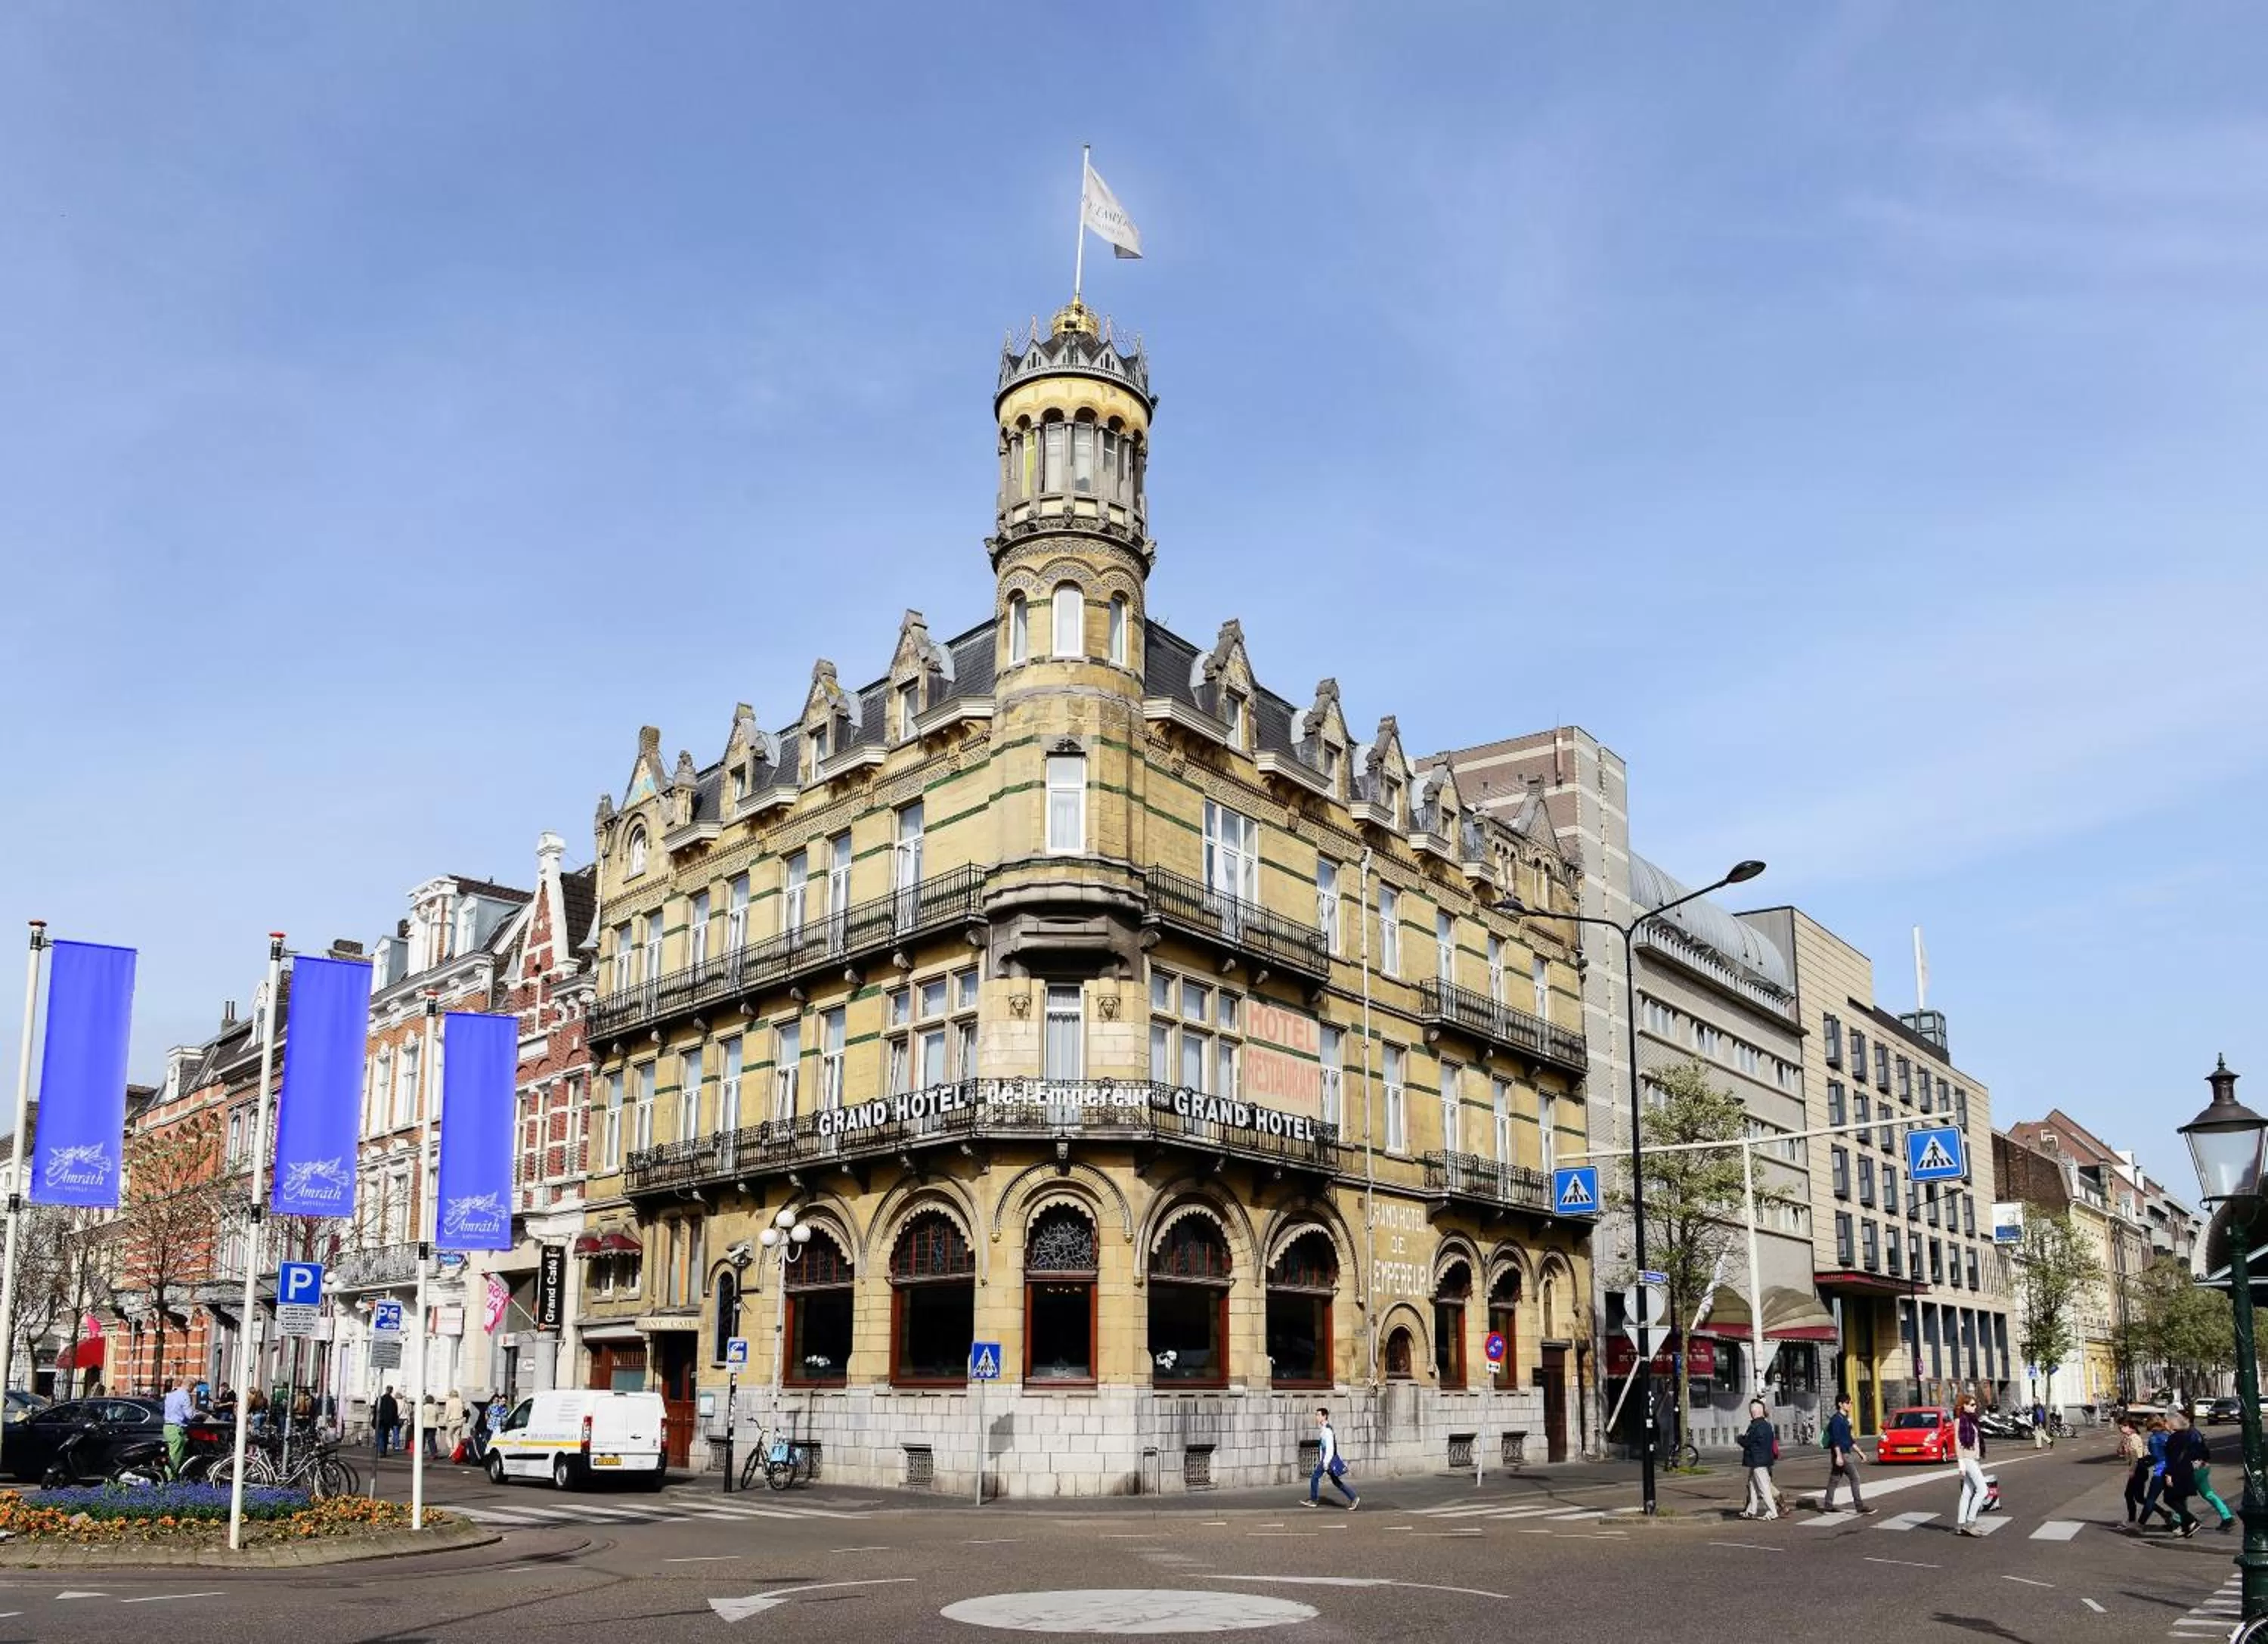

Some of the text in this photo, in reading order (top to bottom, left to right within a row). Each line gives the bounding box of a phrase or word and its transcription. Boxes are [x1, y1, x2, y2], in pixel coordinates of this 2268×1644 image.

[1250, 1002, 1316, 1052] HOTEL
[987, 1080, 1015, 1106] de
[1247, 1050, 1318, 1107] RESTAURANT
[819, 1085, 965, 1136] GRAND HOTEL
[1174, 1090, 1315, 1142] GRAND HOTEL
[1391, 1236, 1405, 1255] DE
[288, 1267, 314, 1300] P
[547, 1258, 558, 1286] Café
[545, 1286, 557, 1323] Grand
